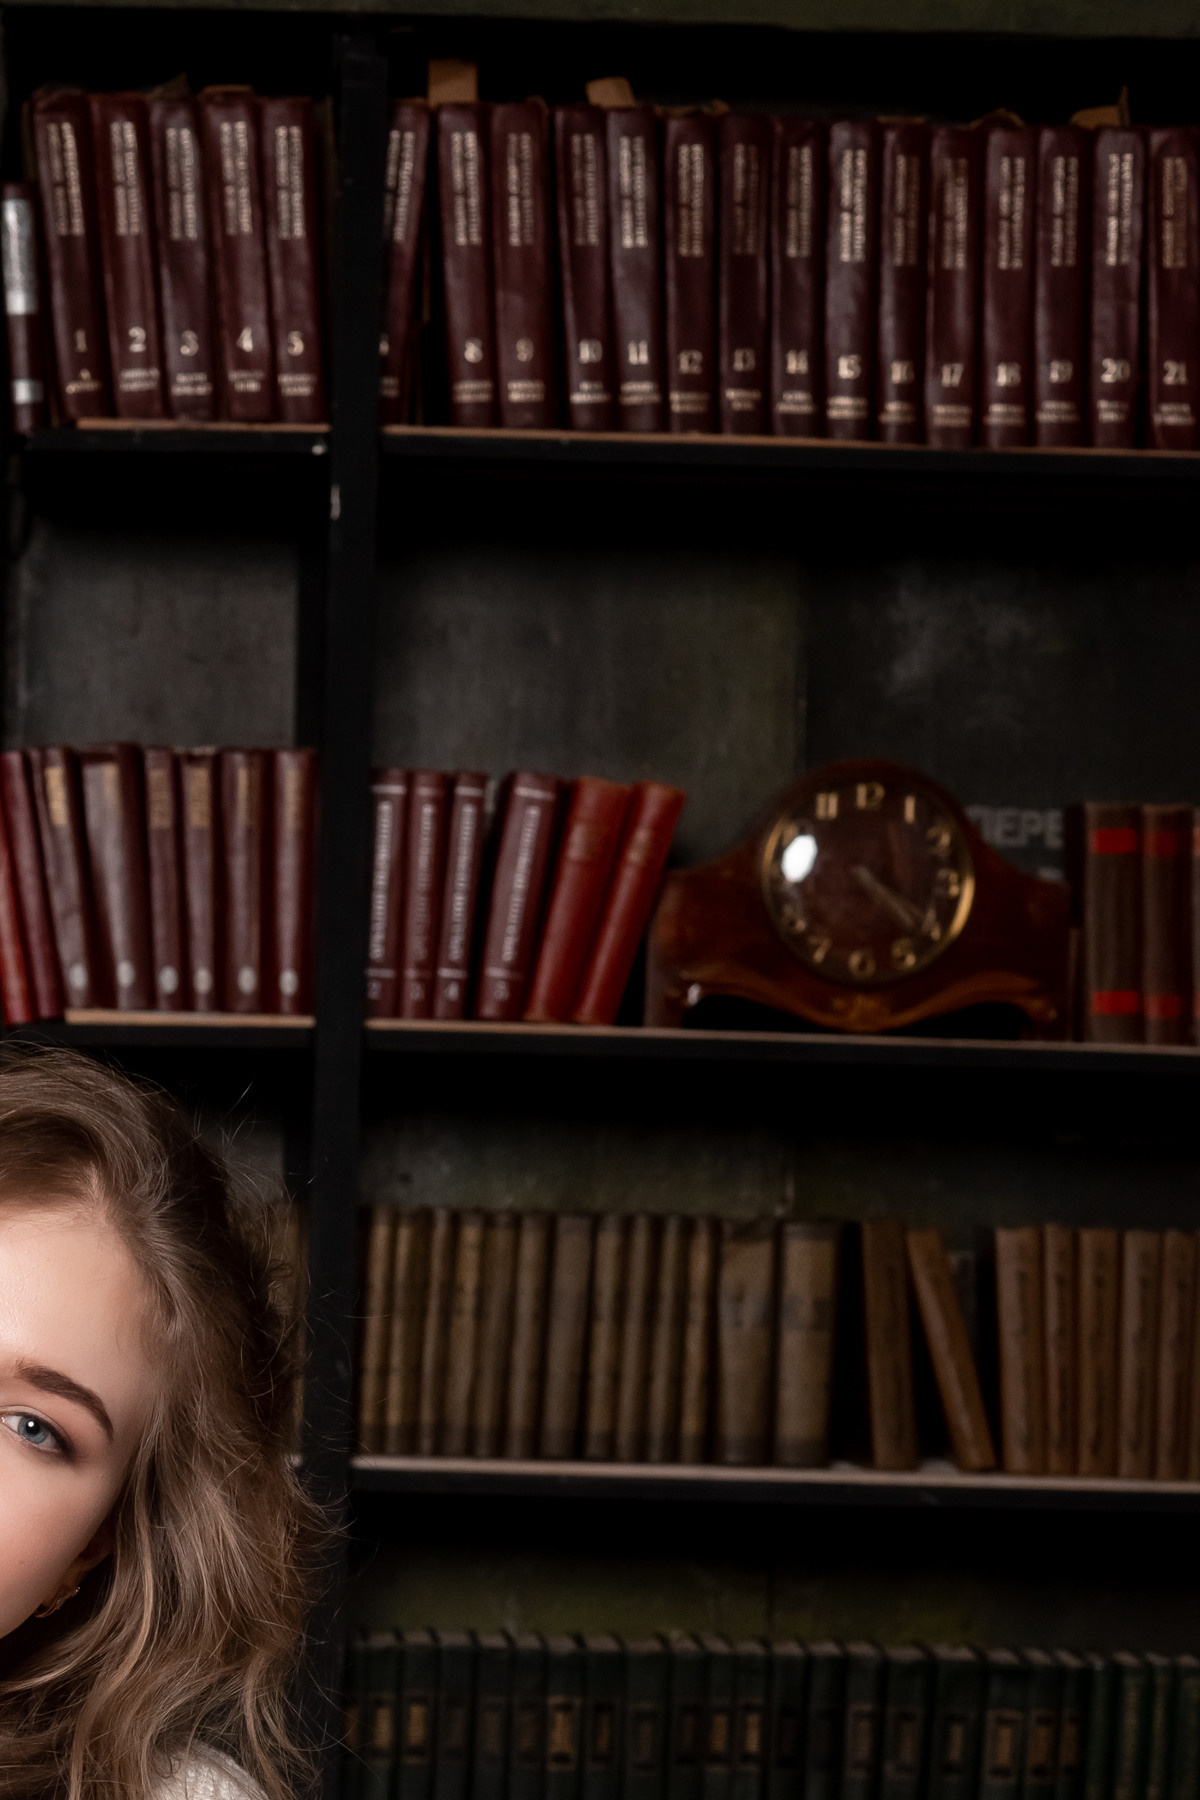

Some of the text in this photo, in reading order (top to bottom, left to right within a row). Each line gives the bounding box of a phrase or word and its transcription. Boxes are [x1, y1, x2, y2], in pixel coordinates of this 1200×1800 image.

[129, 326, 147, 353] 2
[180, 330, 199, 357] 3
[236, 326, 253, 353] 4
[287, 330, 305, 357] 5
[628, 339, 648, 365] 11
[678, 349, 703, 374] 12
[786, 349, 809, 375] 14
[837, 353, 862, 379] 15
[1100, 358, 1130, 383] 20
[1162, 360, 1188, 386] 21
[941, 363, 964, 388] 17
[815, 792, 839, 820] 11
[856, 783, 885, 811] 12
[904, 795, 915, 824] 1
[927, 825, 950, 855] 2
[808, 935, 832, 963] 7
[891, 937, 916, 970] 5
[849, 948, 876, 978] 6
